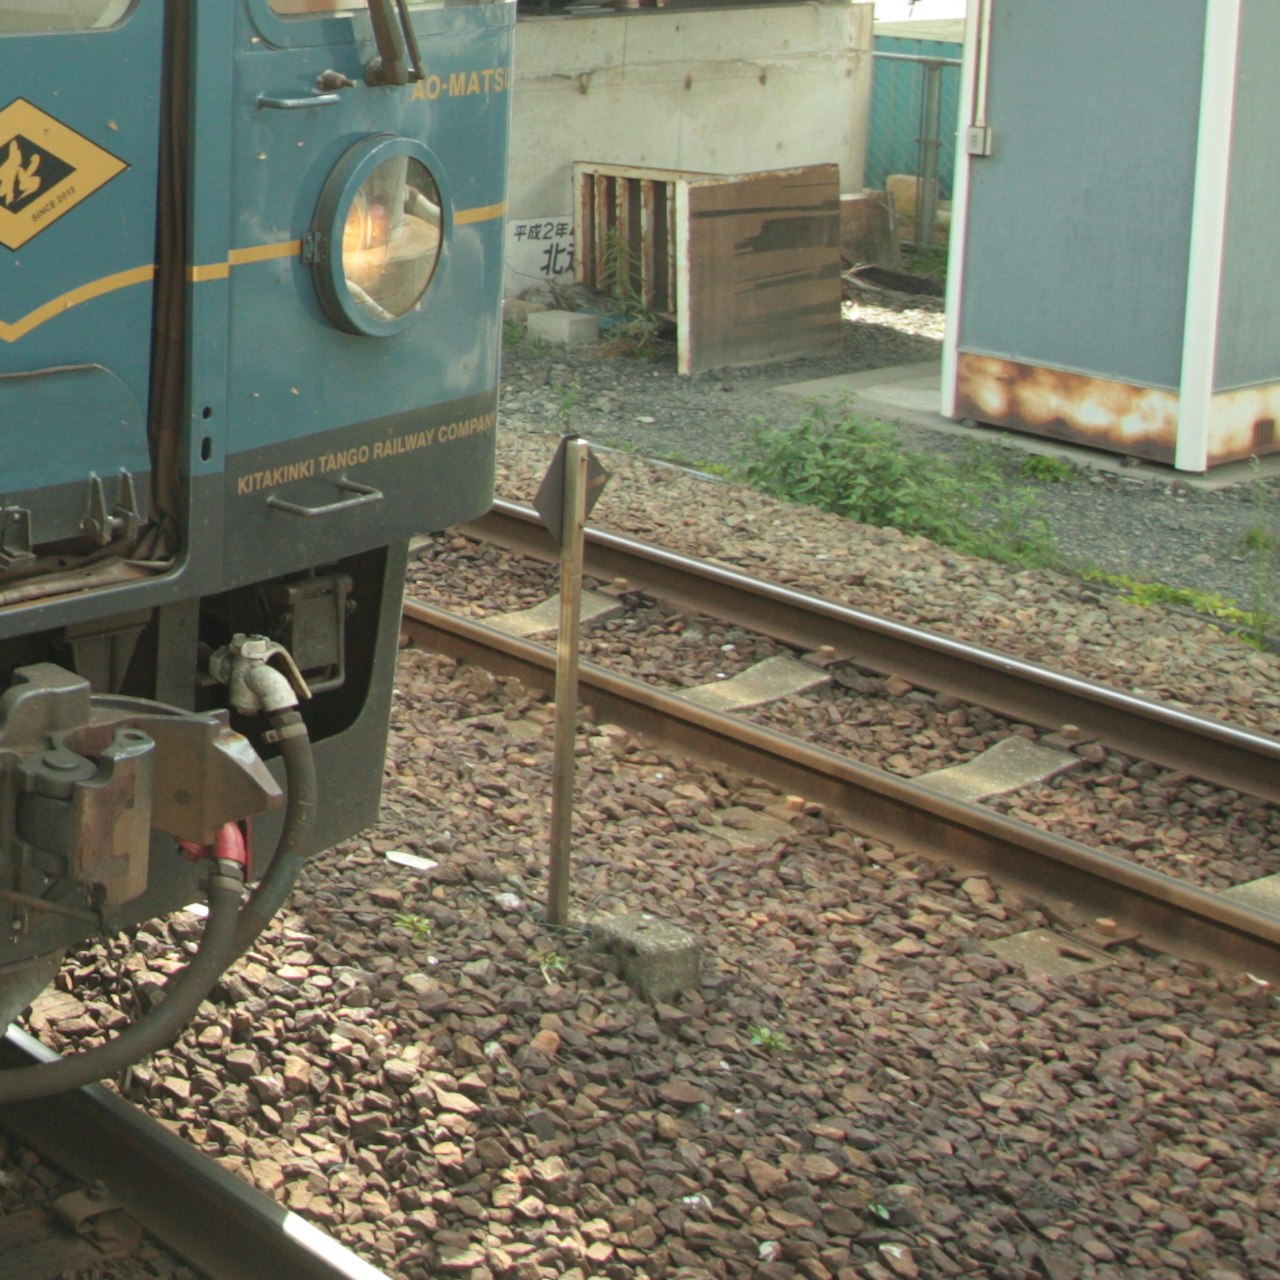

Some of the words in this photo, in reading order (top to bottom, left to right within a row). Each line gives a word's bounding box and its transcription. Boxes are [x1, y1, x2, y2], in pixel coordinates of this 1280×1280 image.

[31, 200, 57, 222] SINCE
[238, 458, 315, 495] KITAKINKI
[319, 445, 370, 473] TANGO
[373, 428, 434, 460] RAILWAY
